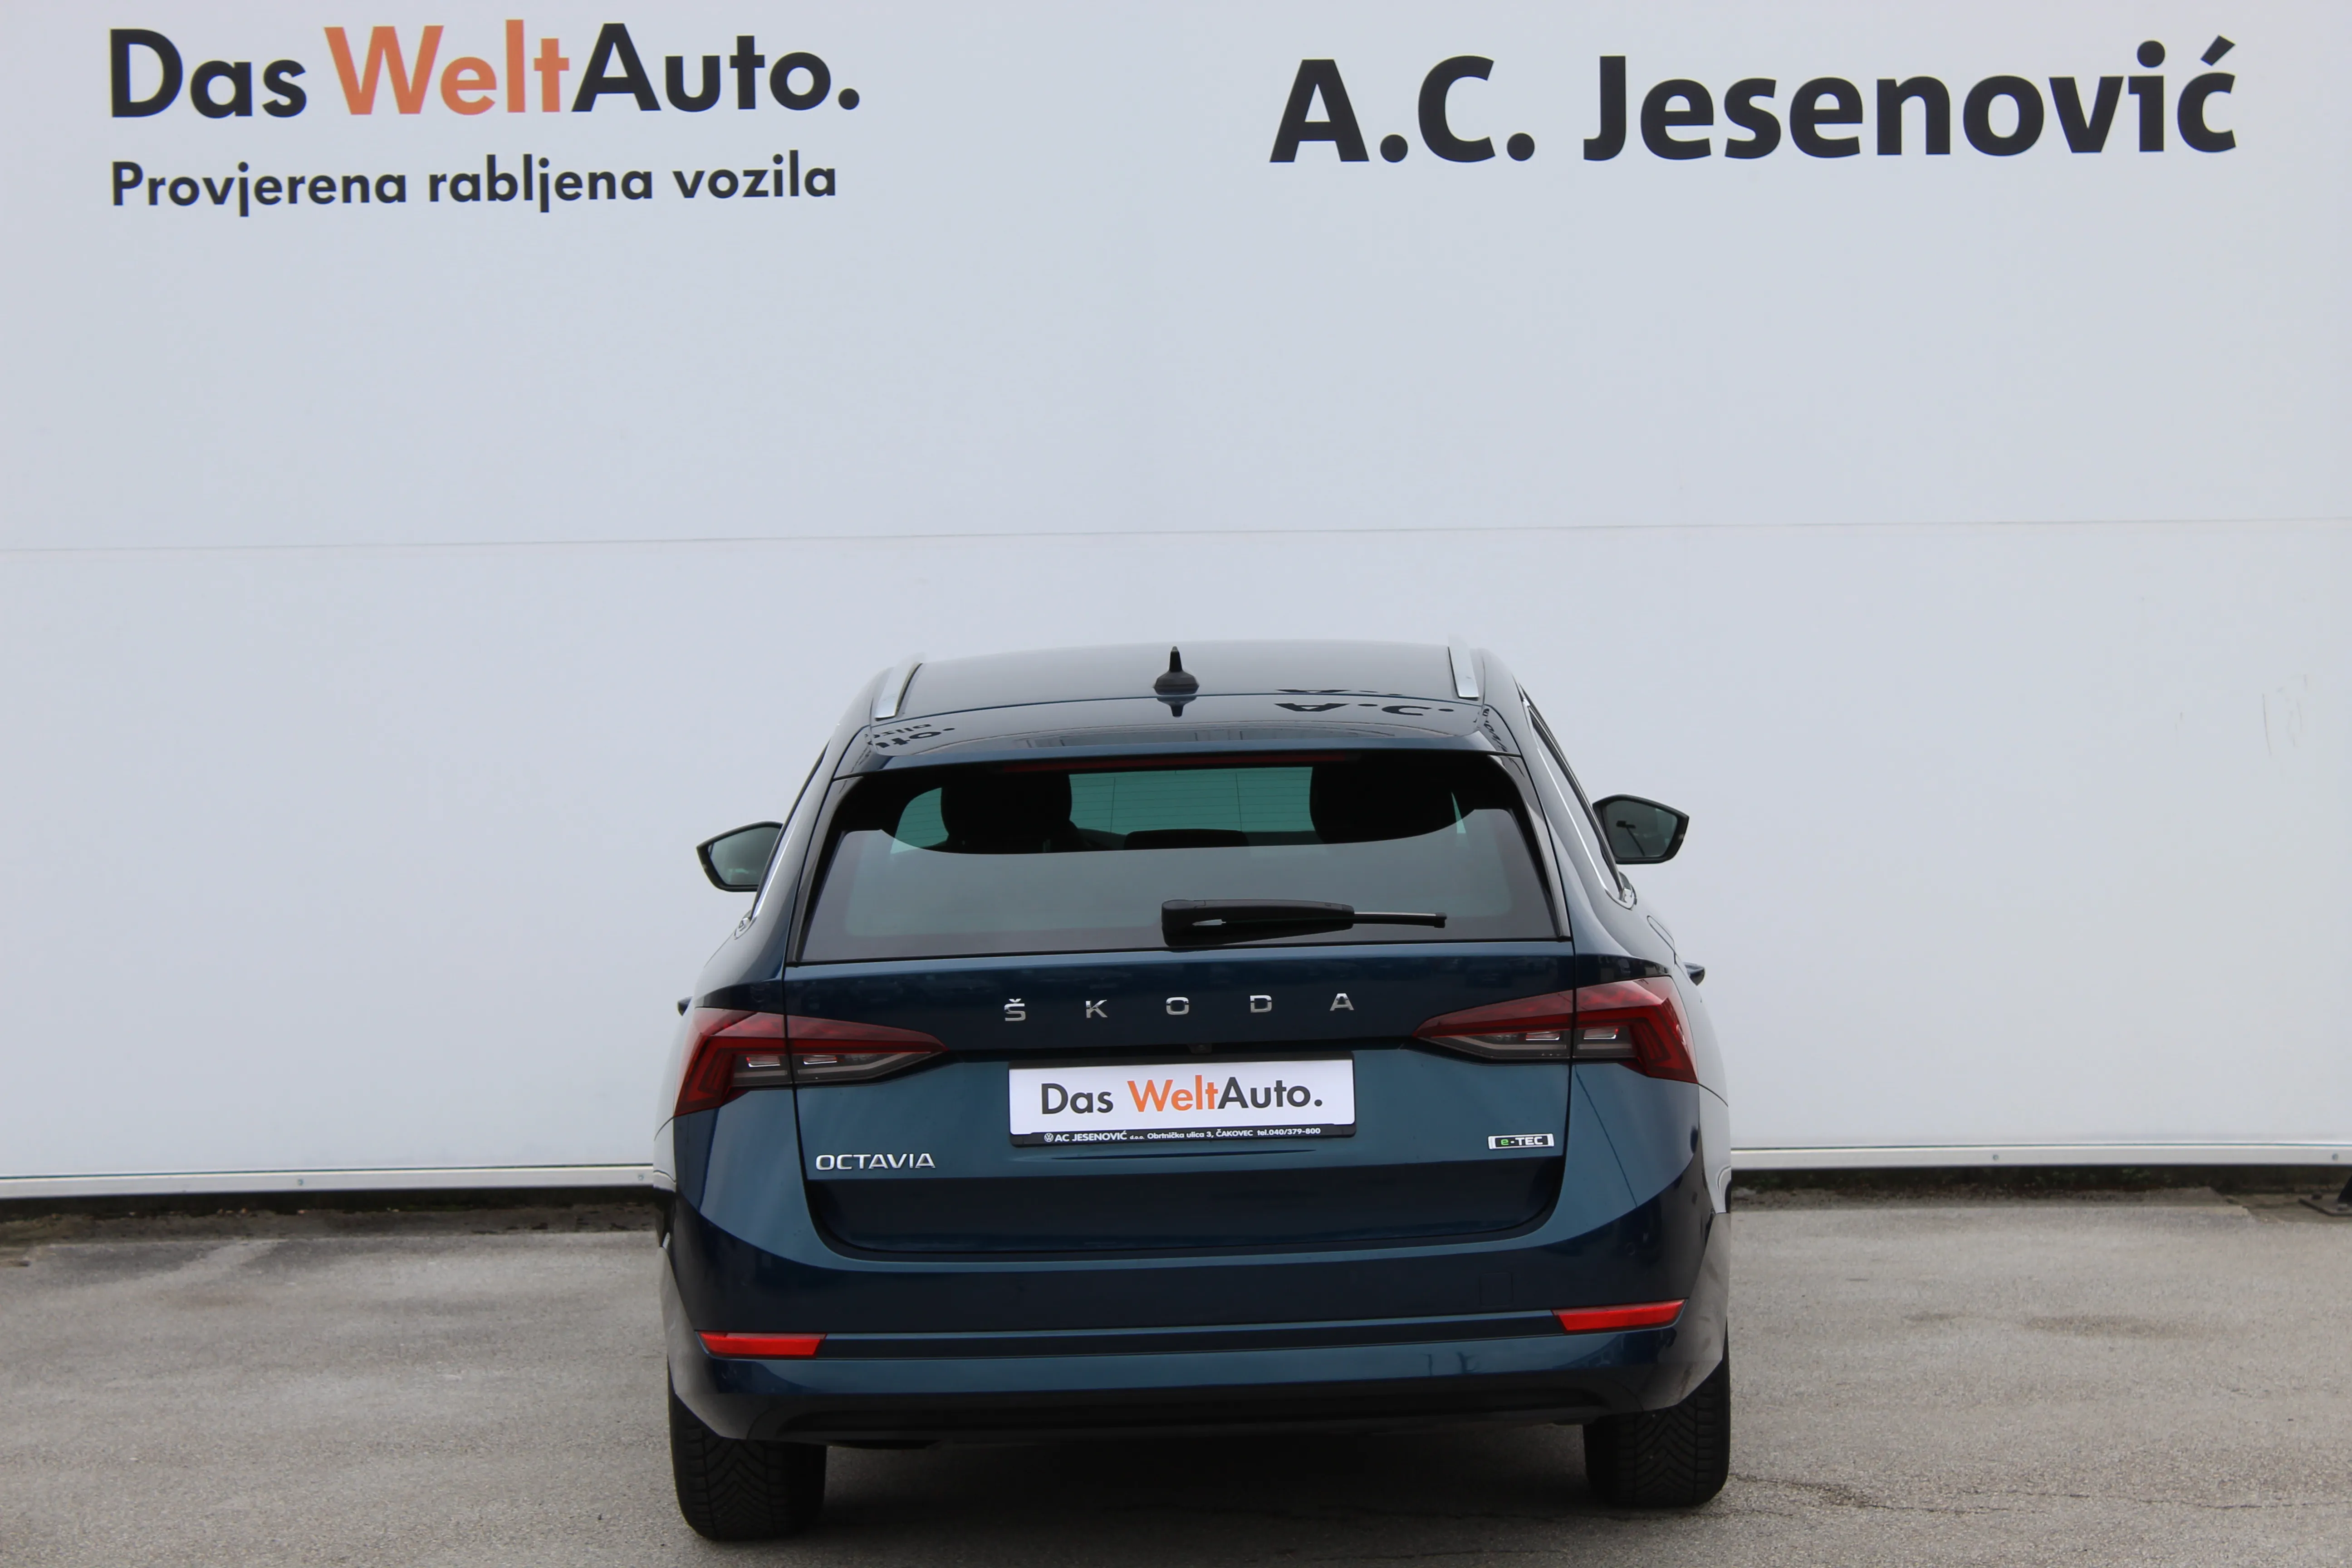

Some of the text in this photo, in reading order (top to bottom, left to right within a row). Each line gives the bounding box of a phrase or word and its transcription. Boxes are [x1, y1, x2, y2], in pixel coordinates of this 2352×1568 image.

[110, 20, 859, 119] Das WeltAuto.
[1269, 36, 2236, 163] A.C. Jesenović
[113, 150, 835, 217] Provjerena rabljena vozila
[1004, 993, 1355, 1022] ŠKODA
[1042, 1075, 1322, 1114] Das WeltAuto.
[1054, 1134, 1069, 1142] AC
[1072, 1130, 1127, 1142] JESENOVIĆ
[1147, 1131, 1184, 1139] Obrtnička
[1216, 1129, 1253, 1137] ČAKOVEC
[1257, 1127, 1321, 1136] tel.040/379-800
[816, 1153, 936, 1170] OCTAVIA
